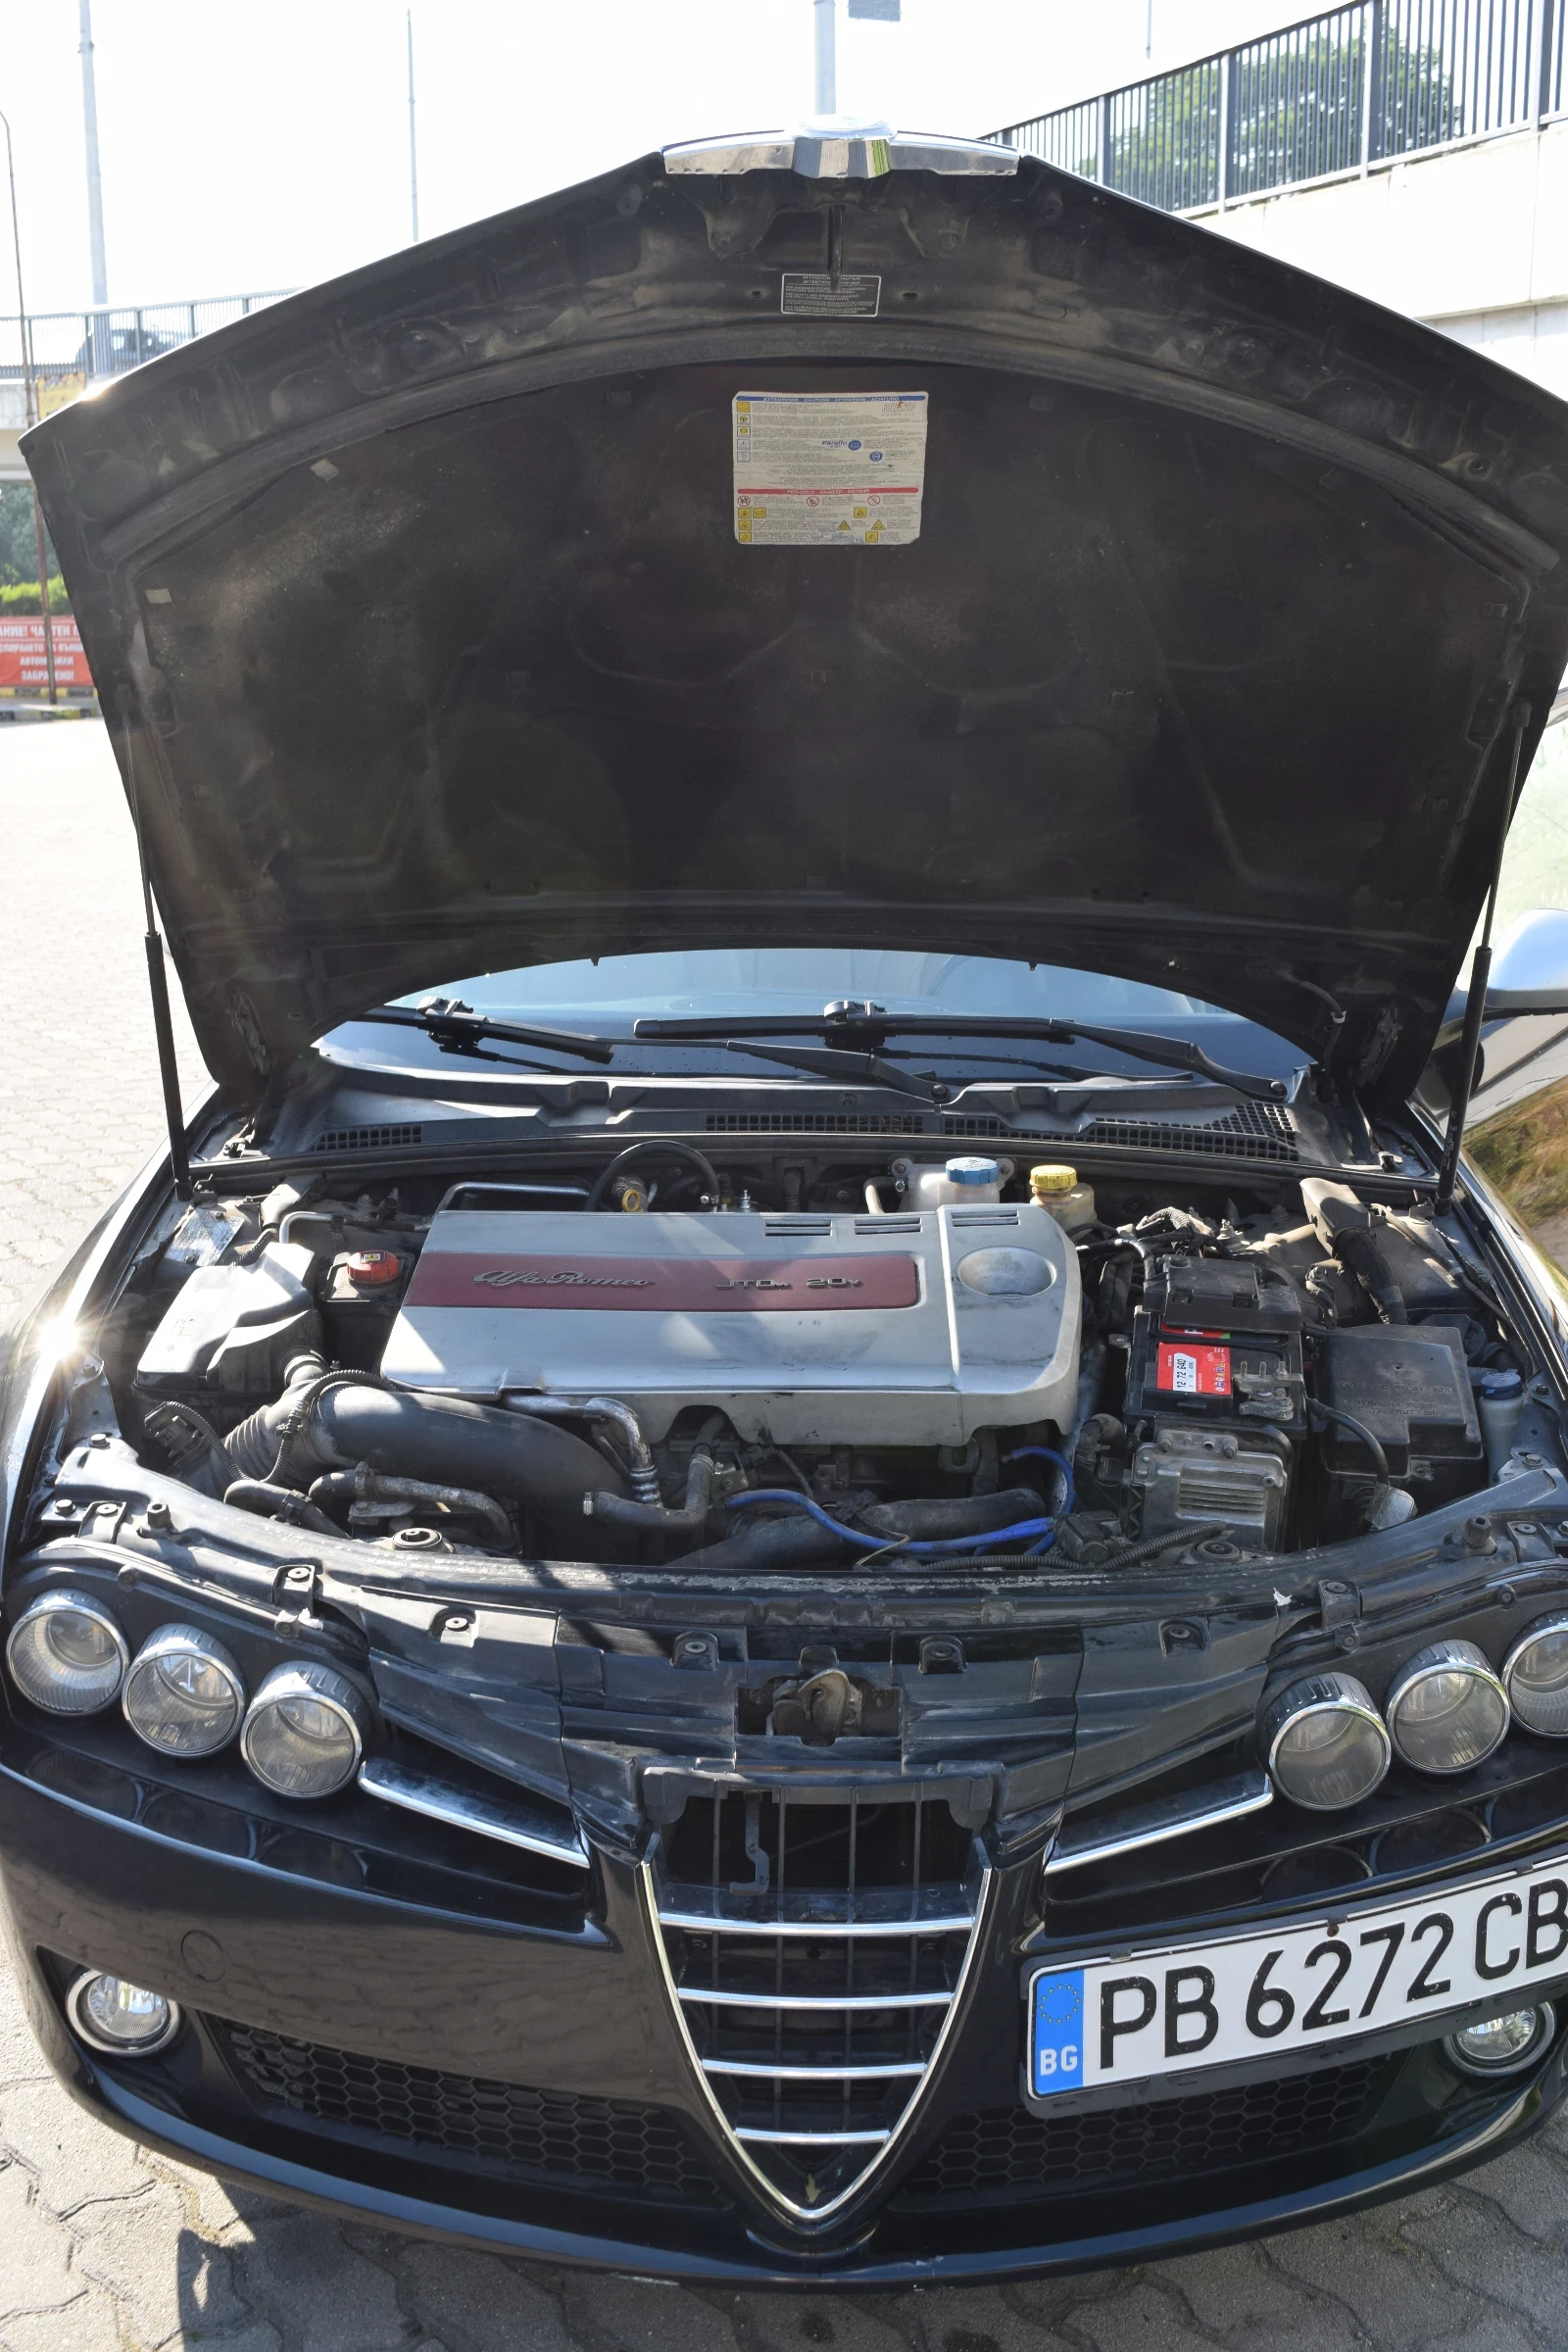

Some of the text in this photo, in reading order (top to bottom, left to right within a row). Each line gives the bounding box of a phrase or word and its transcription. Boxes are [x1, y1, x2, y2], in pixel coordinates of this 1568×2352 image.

[472, 1270, 546, 1287] Alfa
[545, 1270, 655, 1288] Romeo
[1100, 1878, 1568, 2070] PB 6272 CB
[1040, 2047, 1078, 2076] BG
